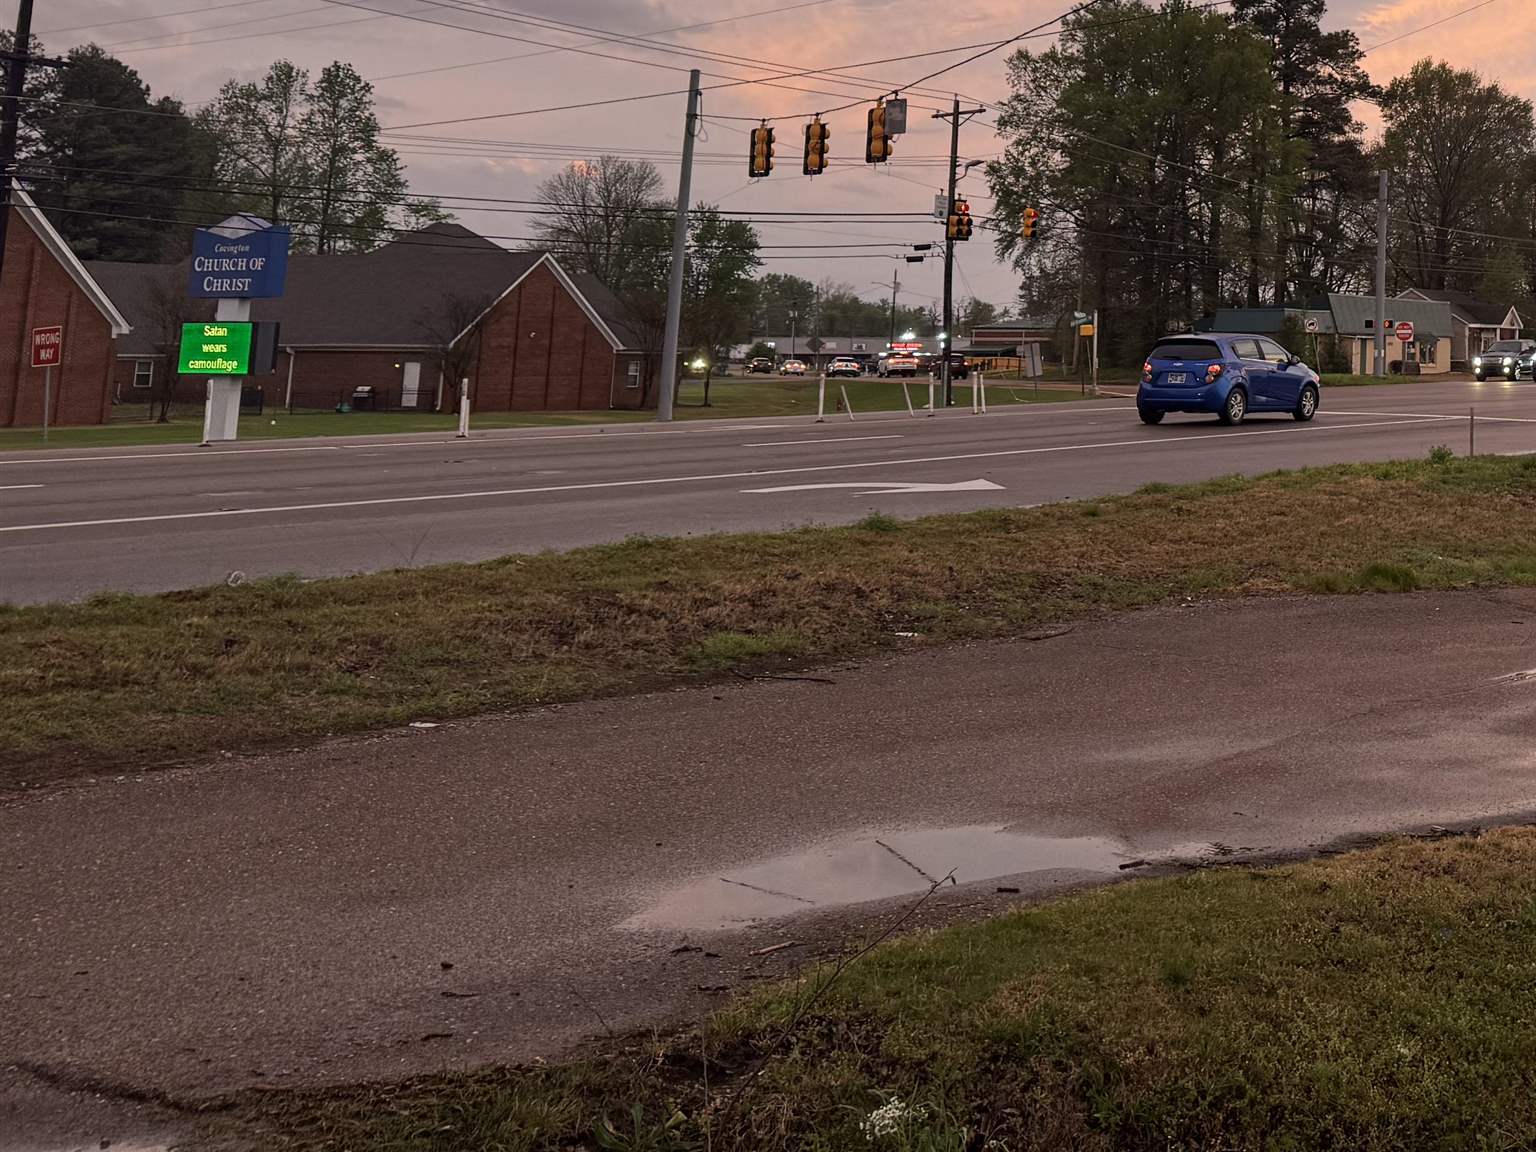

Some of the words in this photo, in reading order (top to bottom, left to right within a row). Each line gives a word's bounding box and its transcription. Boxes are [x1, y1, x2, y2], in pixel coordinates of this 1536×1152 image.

[194, 256, 246, 271] CHURCH
[249, 257, 265, 270] OF
[203, 276, 252, 291] CHRIST
[203, 325, 228, 336] Satan
[35, 332, 60, 345] WRONG
[40, 347, 55, 361] WAY
[202, 344, 227, 353] wears
[188, 358, 238, 372] camouflage
